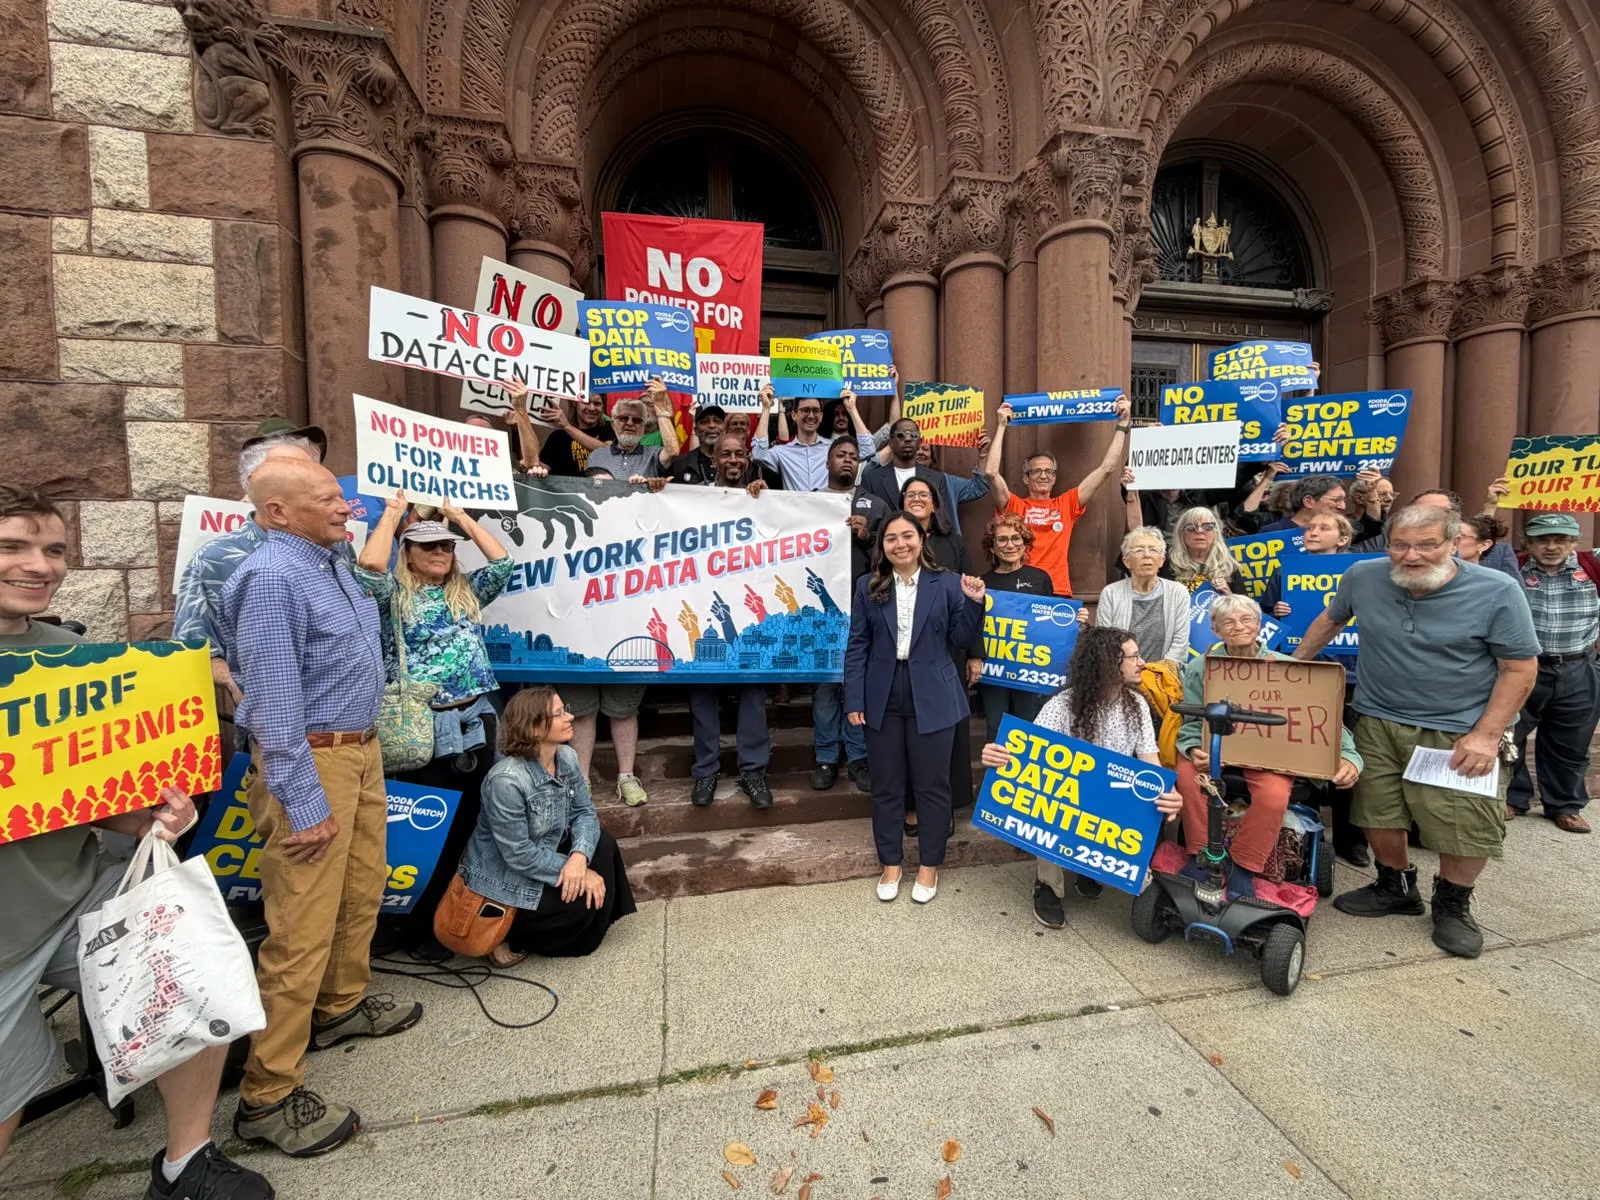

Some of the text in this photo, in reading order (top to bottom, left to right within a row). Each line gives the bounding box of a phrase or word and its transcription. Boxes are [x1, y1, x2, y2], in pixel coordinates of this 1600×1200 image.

[647, 247, 723, 297] NO
[1203, 262, 1218, 275] 24
[487, 273, 562, 330] NO
[586, 308, 649, 327] STOP
[703, 303, 743, 330] FOR
[1133, 317, 1269, 337] CITY HALL
[588, 329, 651, 347] DATA
[812, 335, 856, 348] TOP
[592, 347, 691, 370] CENTERS
[775, 342, 838, 358] Environmental
[1214, 345, 1268, 364] STOP
[700, 361, 771, 376] NO POWER
[784, 362, 834, 376] Advocates
[1214, 356, 1267, 376] DATA
[593, 377, 612, 386] TEXT
[612, 370, 650, 384] FWW
[661, 371, 695, 388] 23321
[712, 377, 760, 391] FOR AI
[802, 383, 817, 393] NY
[862, 381, 892, 389] 23321
[1047, 389, 1102, 400] WATER
[1165, 386, 1204, 405] NO
[906, 396, 971, 418] OUR TURF
[1027, 404, 1063, 417] FWW
[1076, 402, 1116, 414] 23321
[1174, 403, 1238, 424] RATE
[1286, 401, 1360, 422] STOP
[945, 410, 982, 428] TERMS
[370, 410, 499, 458] NO POWER
[1287, 421, 1354, 441] DATA
[1132, 445, 1236, 467] NO MORE DATA CENTERS
[1283, 436, 1398, 458] CENTERS
[395, 442, 480, 478] FOR AI
[1300, 460, 1344, 472] FWW
[1513, 459, 1565, 479] OUR
[367, 462, 510, 501] OLIGARCHS
[1520, 477, 1573, 496] OUR
[200, 510, 245, 533] NO
[507, 517, 753, 593] EW YORK FIGHTS
[1230, 540, 1284, 561] TOP
[583, 528, 830, 606] AI DATA CENTERS
[1241, 559, 1281, 579] ATA
[984, 616, 1028, 640] ATE
[983, 637, 1051, 666] IKES
[1006, 671, 1017, 679] TO
[1018, 669, 1067, 687] 23321
[1207, 661, 1312, 684] PROTECT
[0, 671, 137, 737] TURF
[1249, 690, 1282, 702] OUR
[32, 695, 205, 776] TERMS
[1232, 704, 1330, 747] ATER
[1005, 729, 1096, 777] STOP
[1107, 762, 1135, 776] FOOD&
[996, 757, 1080, 805] DATA
[1107, 769, 1162, 792] WATER WATCH
[386, 795, 414, 806] OOD&
[386, 804, 444, 818] ATER WATCH
[990, 781, 1143, 855] CENTERS
[980, 810, 1140, 882] TEXT FWW TO 23321
